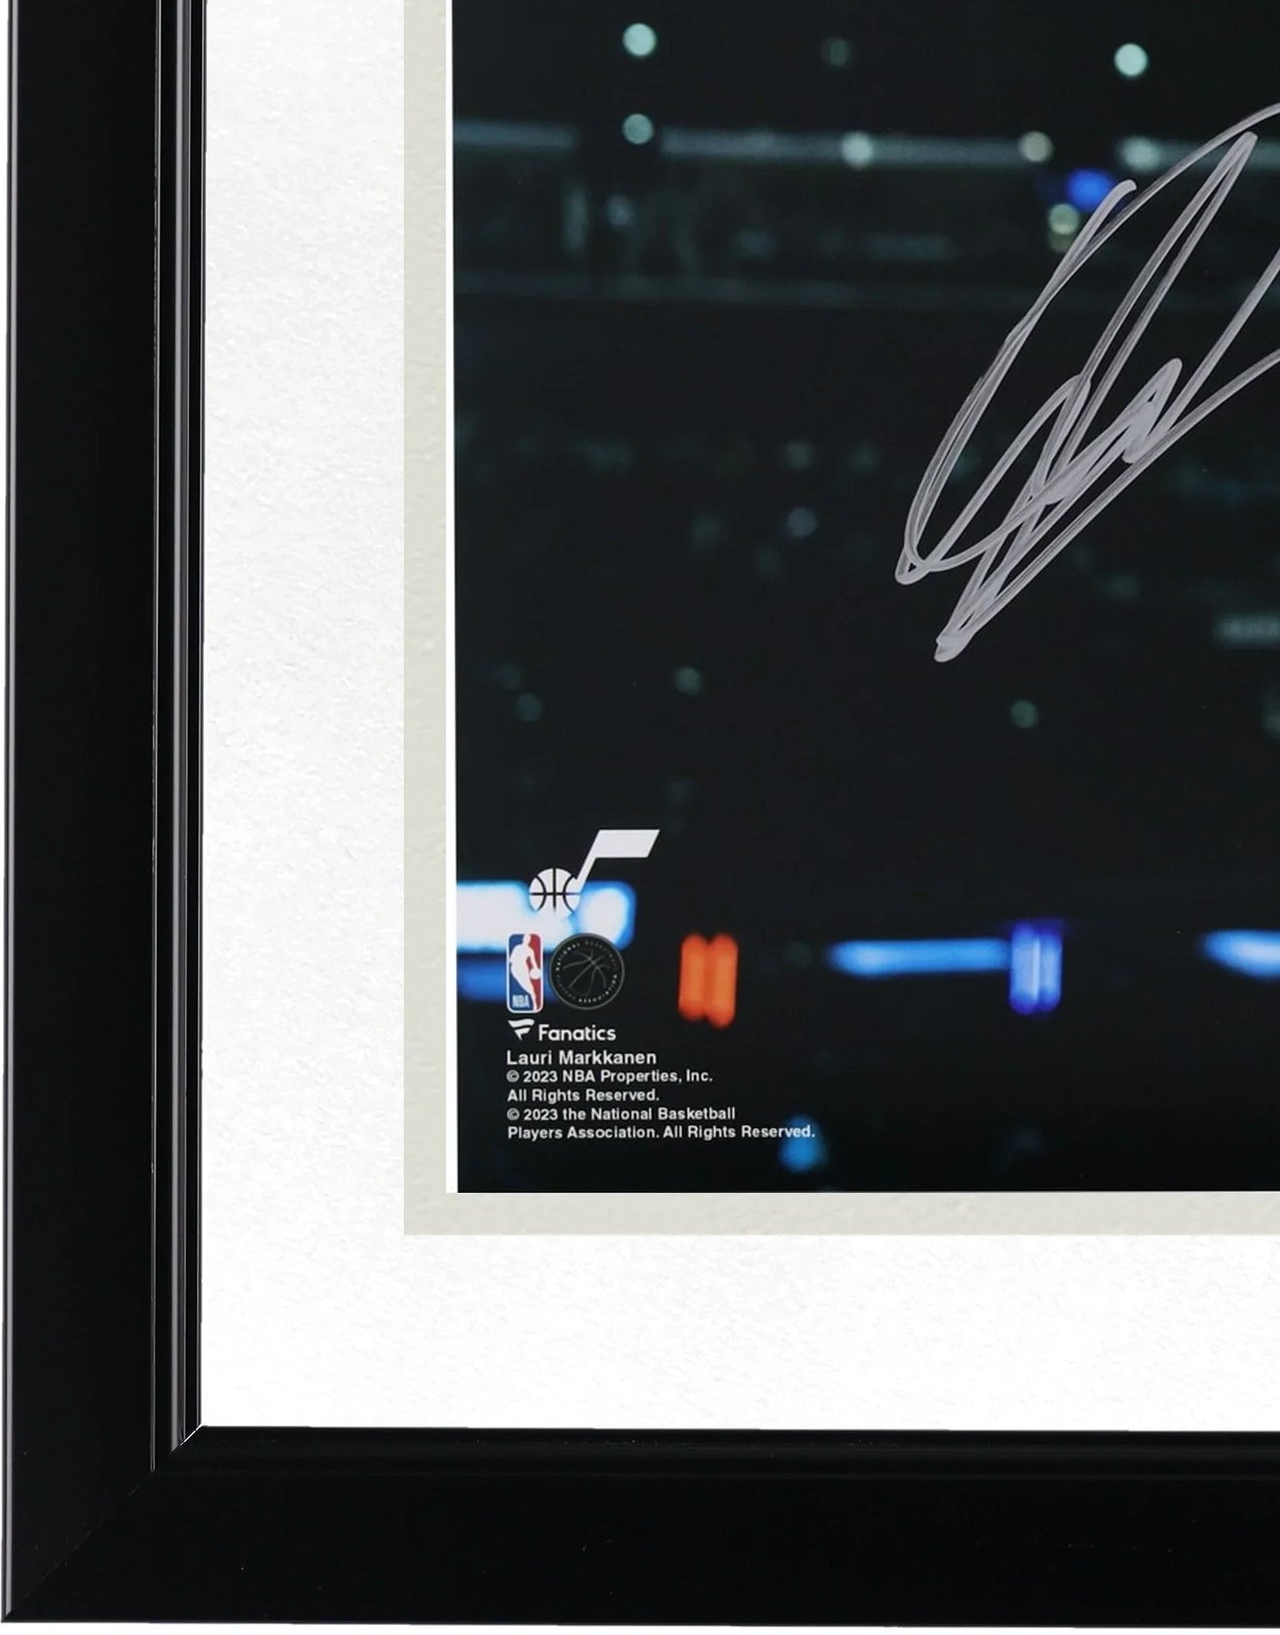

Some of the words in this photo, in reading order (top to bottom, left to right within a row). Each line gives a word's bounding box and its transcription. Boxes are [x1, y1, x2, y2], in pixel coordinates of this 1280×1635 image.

[538, 1023, 617, 1041] Fanatics
[507, 1050, 551, 1065] Lauri
[558, 1050, 657, 1065] Markkanen
[507, 1070, 520, 1082] ©
[523, 1070, 558, 1082] 2023
[562, 1070, 596, 1082] NBA
[600, 1070, 682, 1084] Properties,
[686, 1070, 713, 1082] Inc.
[508, 1089, 527, 1101] All
[532, 1089, 580, 1104] Rights
[585, 1089, 660, 1101] Reserved.
[507, 1108, 520, 1120] ©
[523, 1108, 559, 1120] 2023
[562, 1108, 587, 1120] the
[591, 1108, 652, 1120] National
[658, 1107, 736, 1120] Basketball
[508, 1126, 563, 1141] Players
[567, 1126, 660, 1138] Association.
[663, 1126, 683, 1138] All
[687, 1125, 736, 1140] Rights
[741, 1125, 816, 1138] Reserved.
